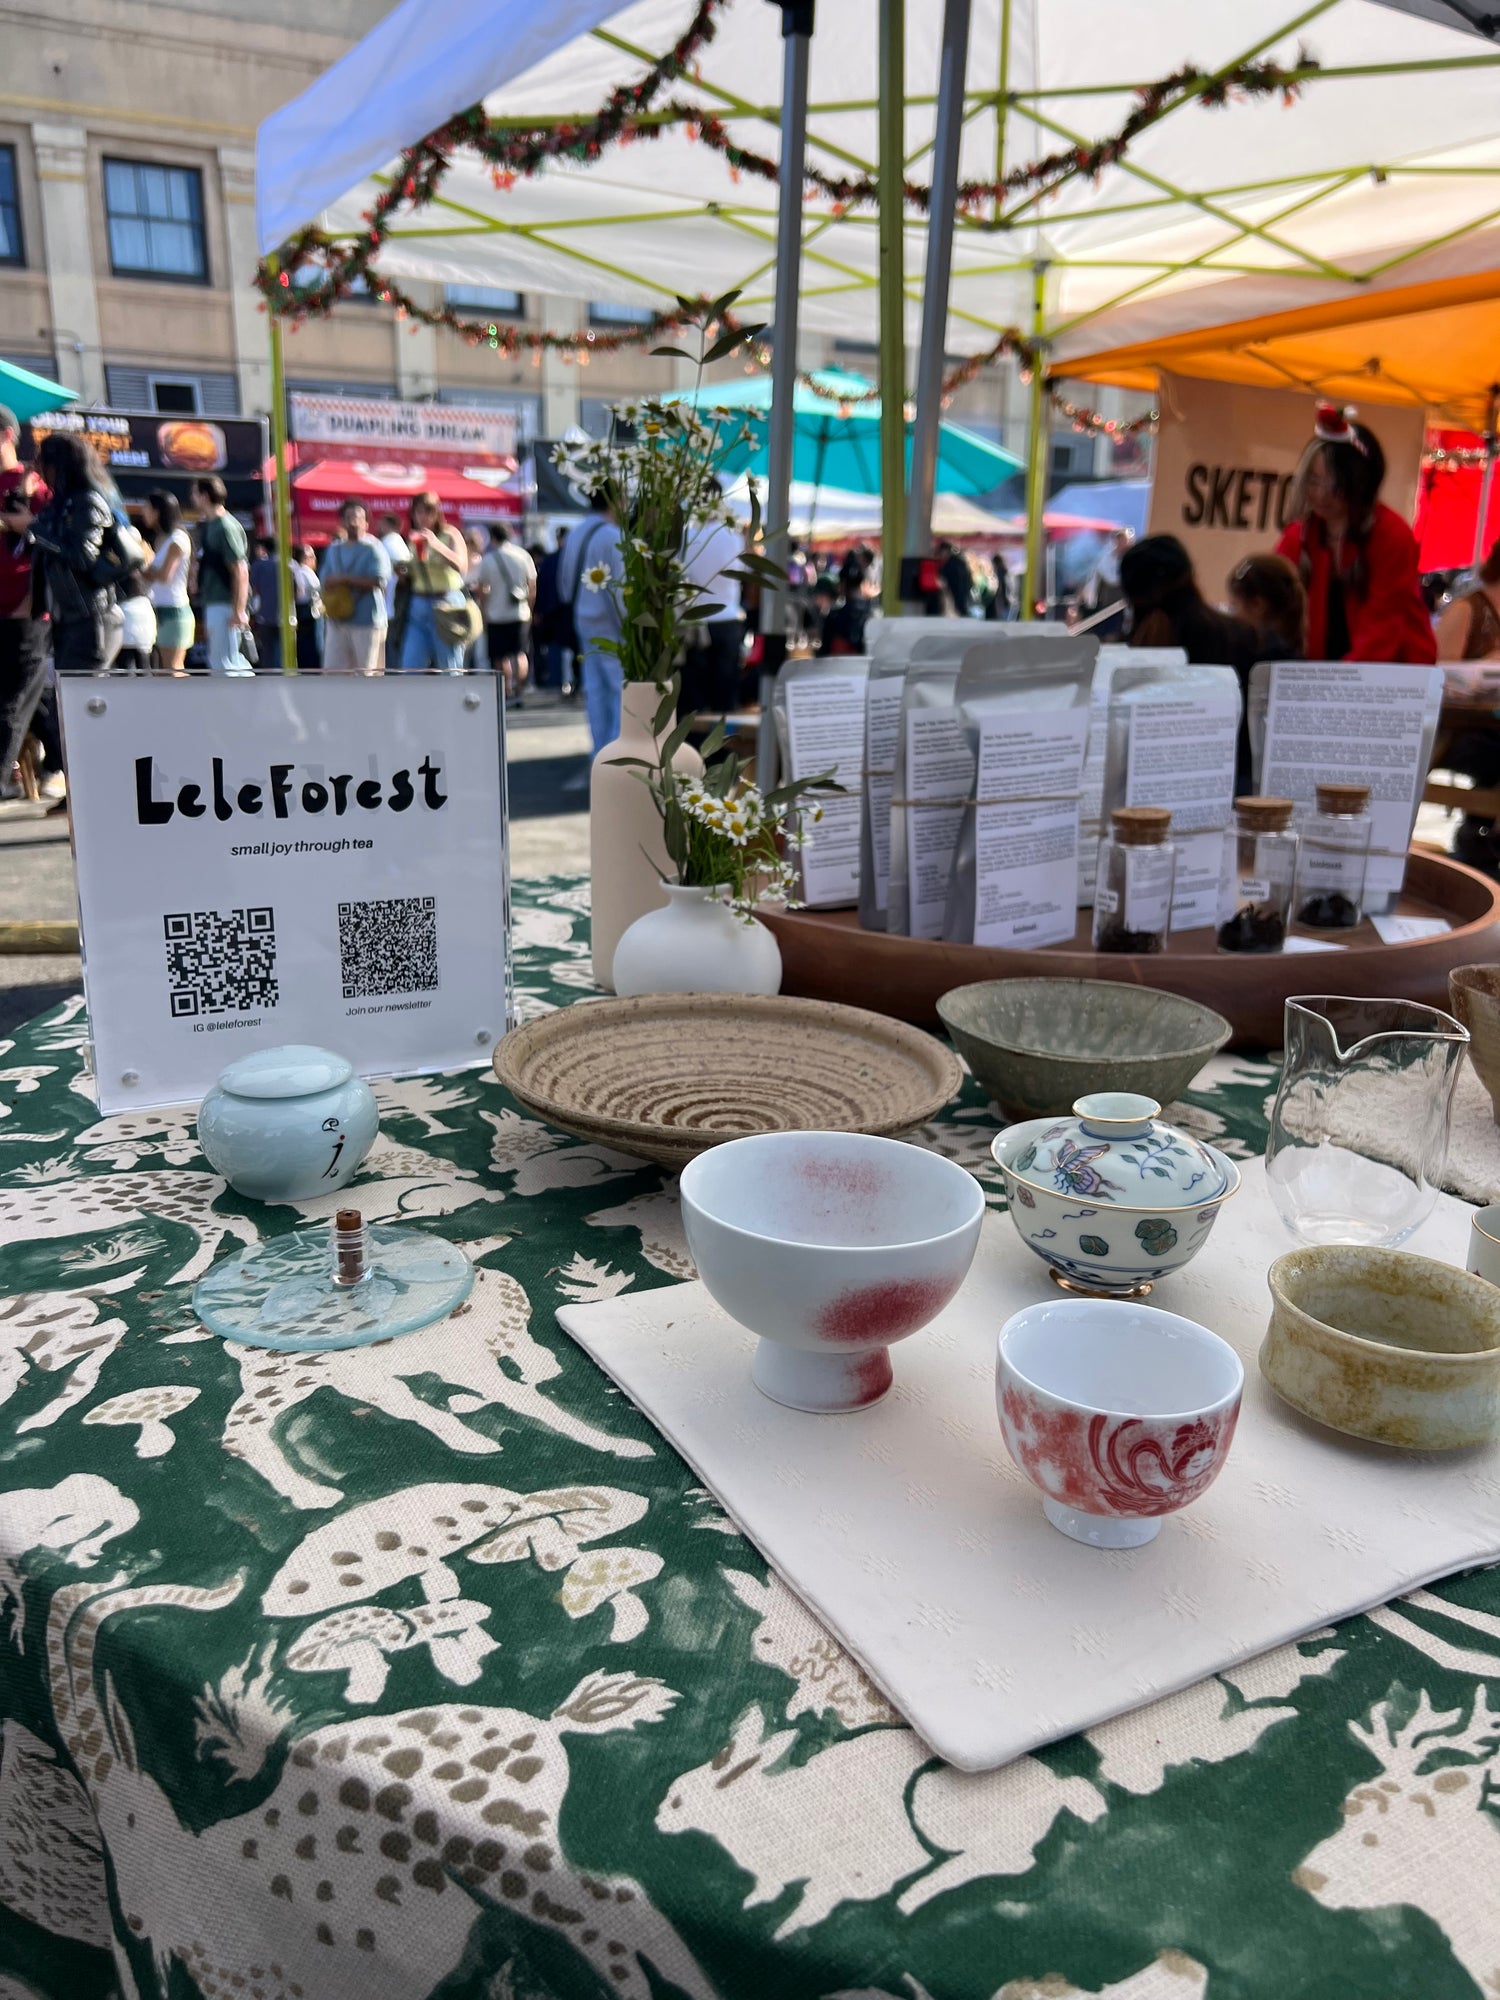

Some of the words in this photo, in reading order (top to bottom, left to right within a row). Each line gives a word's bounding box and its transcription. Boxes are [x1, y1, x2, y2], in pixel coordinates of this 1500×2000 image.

[330, 416, 420, 436] DUMPLING
[111, 450, 149, 467] HERE
[135, 756, 449, 825] LeleForest
[231, 842, 269, 856] small
[270, 843, 293, 857] joy
[294, 839, 351, 854] through
[352, 838, 374, 850] tea
[345, 1006, 367, 1017] Join
[368, 1005, 384, 1014] our
[385, 1001, 432, 1013] newsletter
[193, 1023, 205, 1033] IG
[206, 1018, 262, 1032] @leleforest
